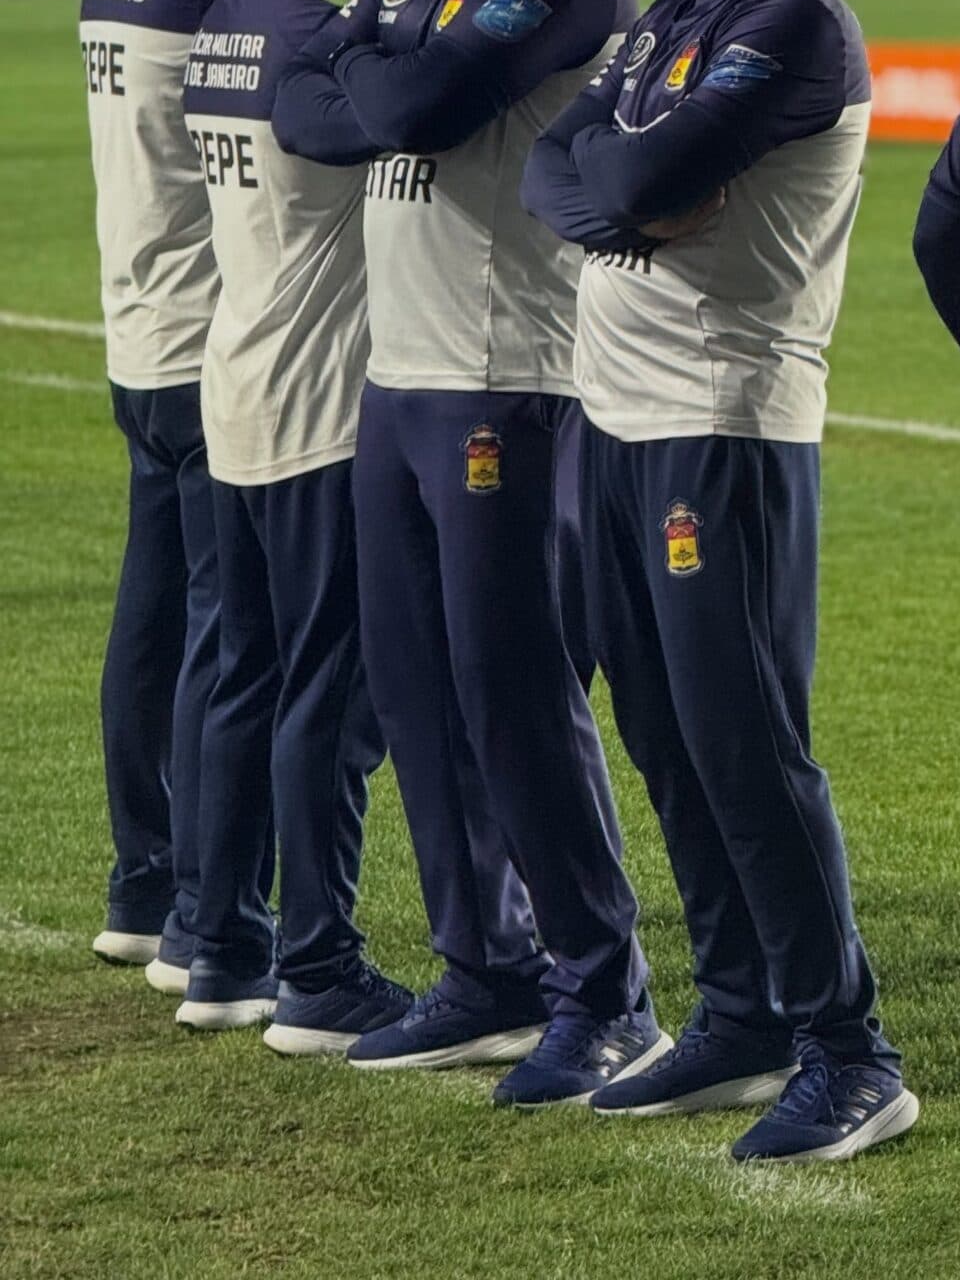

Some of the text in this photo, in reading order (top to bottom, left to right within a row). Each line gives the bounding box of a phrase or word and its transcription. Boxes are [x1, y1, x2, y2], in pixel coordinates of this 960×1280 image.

[212, 33, 265, 59] MILITAR
[189, 61, 204, 87] DE
[204, 62, 260, 91] JANEIRO
